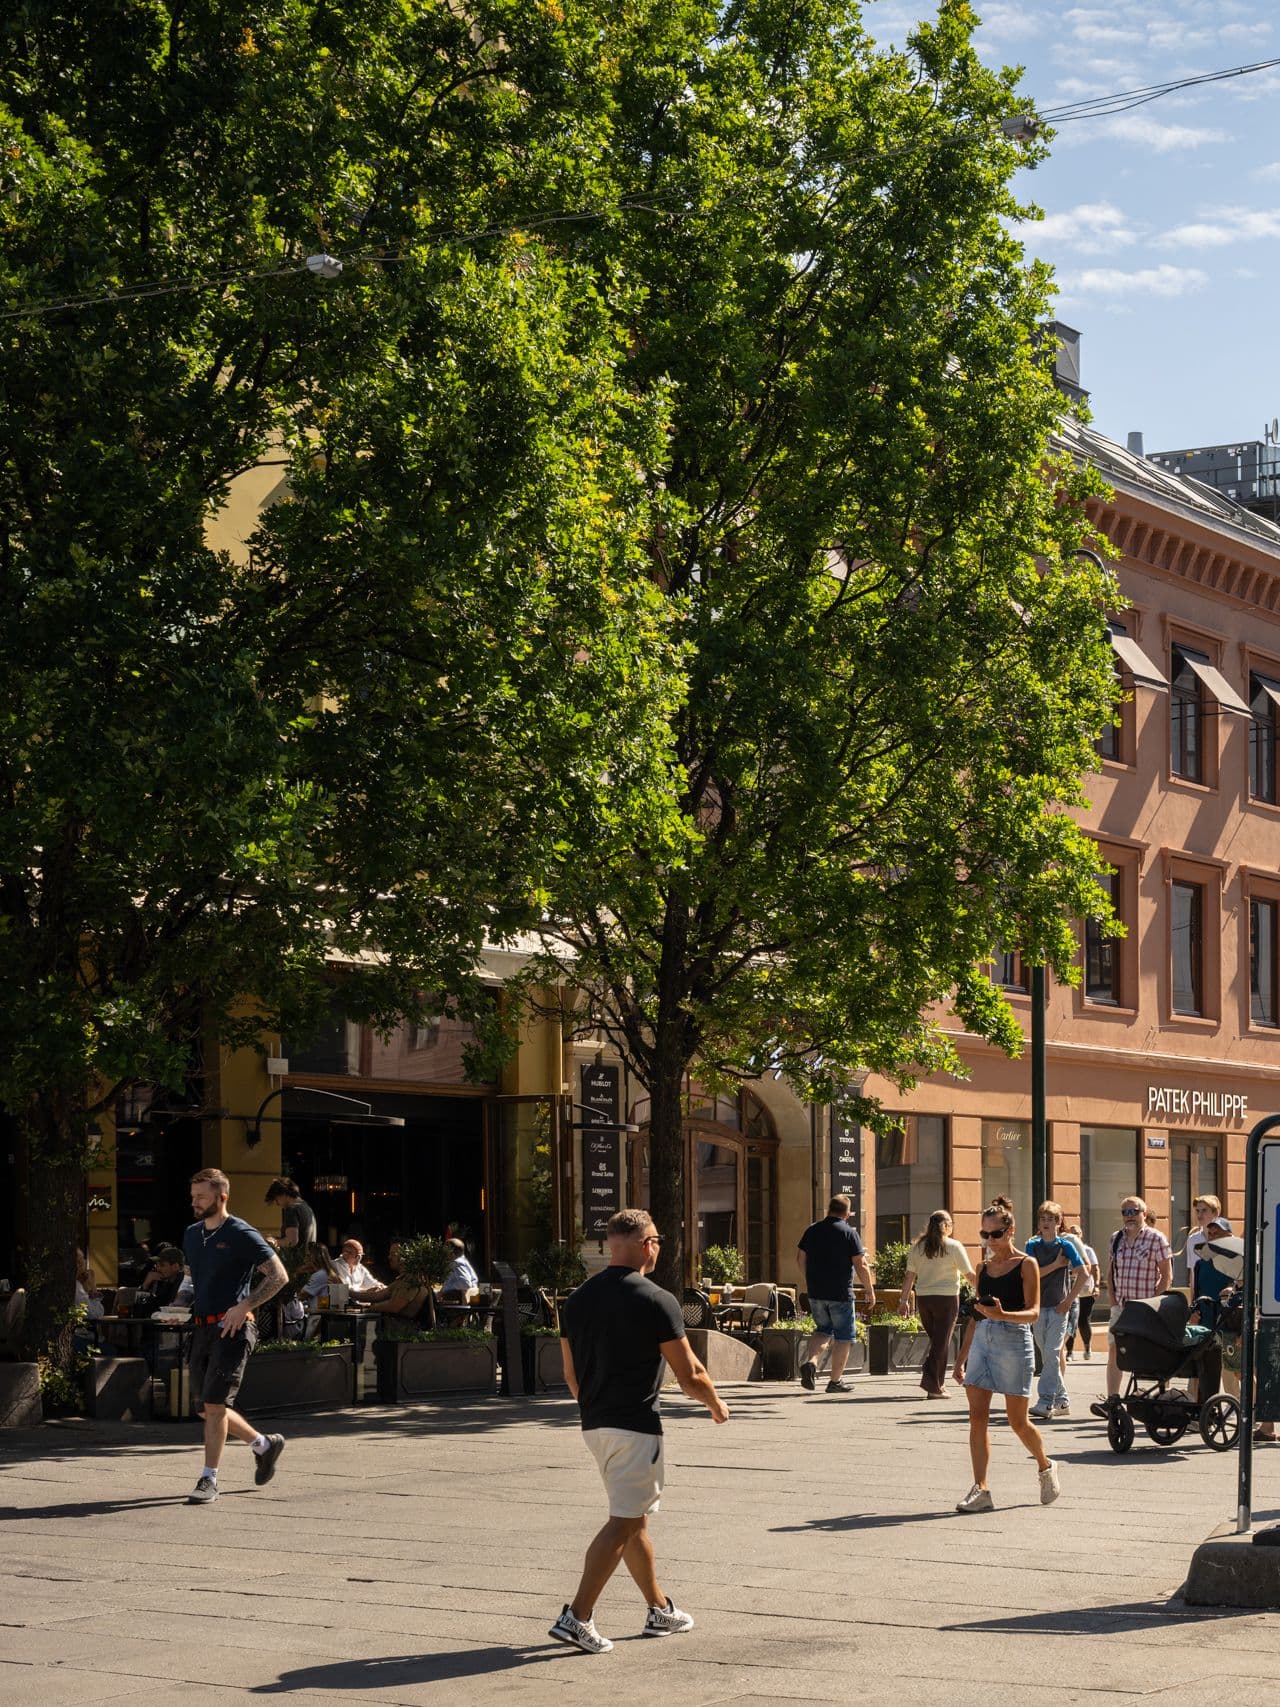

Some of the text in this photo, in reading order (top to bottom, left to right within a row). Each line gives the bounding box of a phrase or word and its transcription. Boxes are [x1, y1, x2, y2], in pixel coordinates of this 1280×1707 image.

[1148, 1086, 1249, 1119] PATEK PHILIPPE
[996, 1127, 1022, 1141] Cartier
